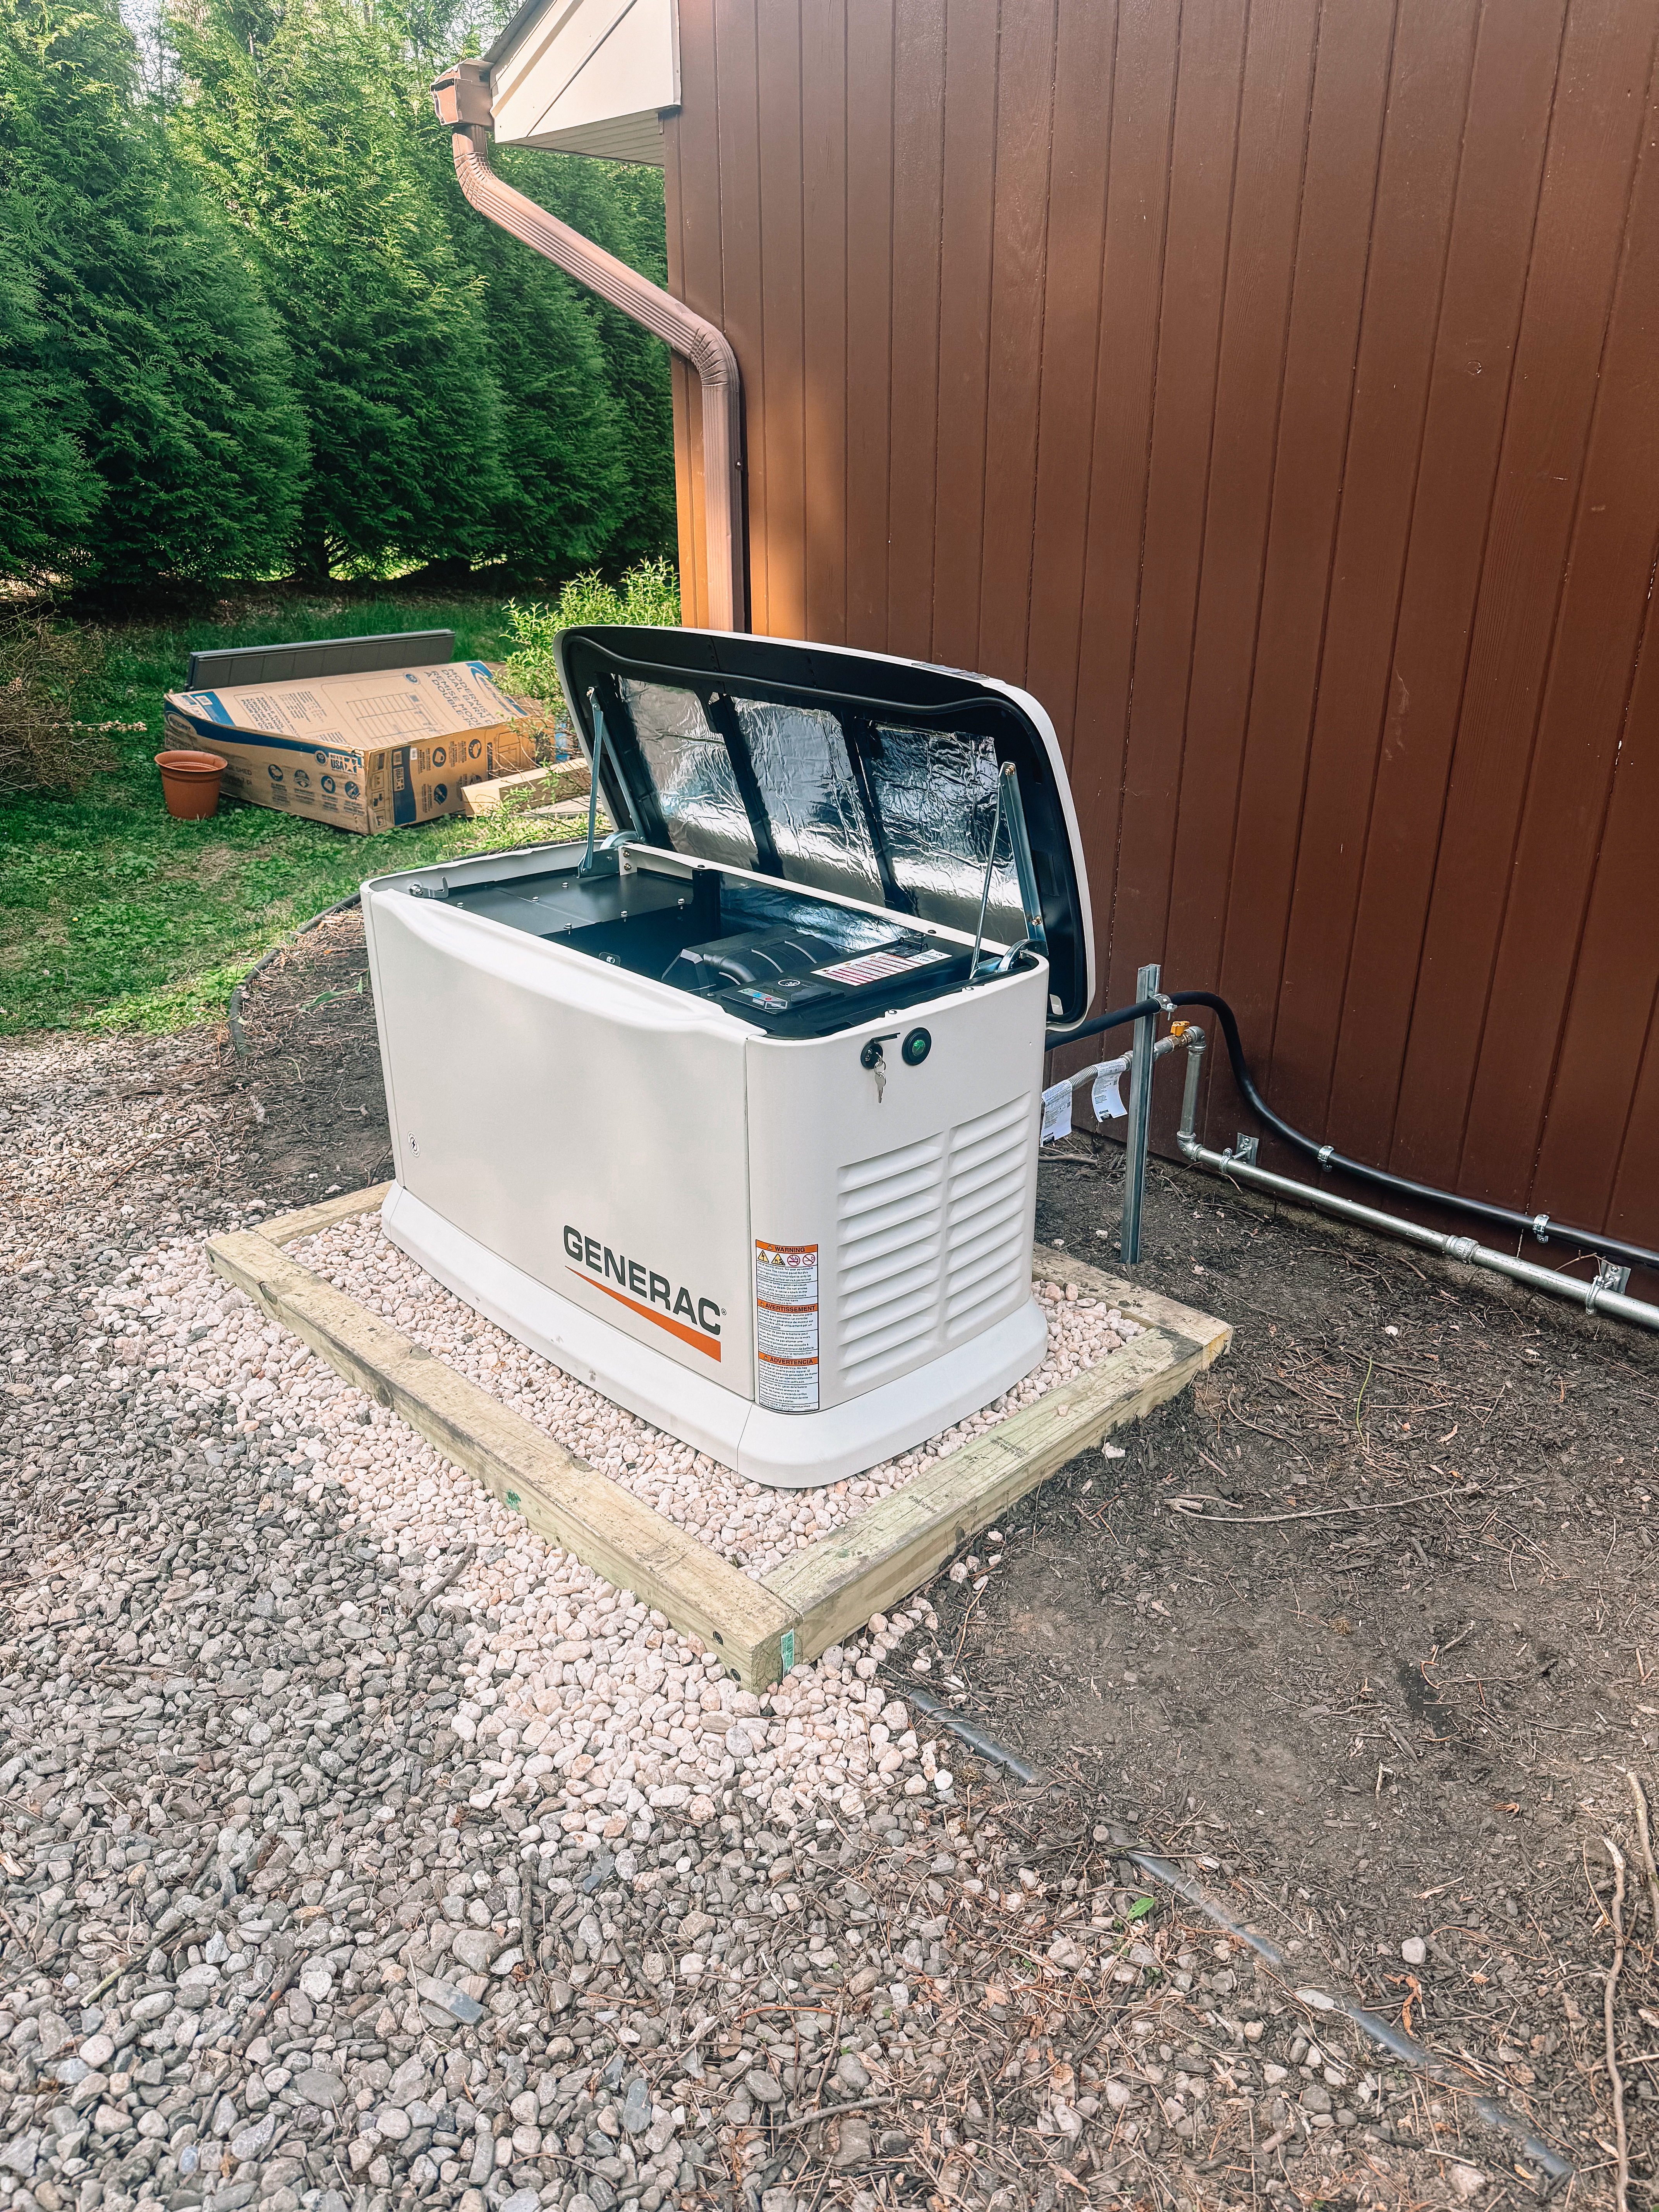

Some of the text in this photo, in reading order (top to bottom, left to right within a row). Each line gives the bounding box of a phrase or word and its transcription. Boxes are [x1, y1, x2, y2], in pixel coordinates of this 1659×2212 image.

[430, 671, 461, 702] REMISE
[440, 669, 465, 692] DUAL
[462, 695, 486, 718] BARN
[331, 759, 344, 771] USA
[563, 1225, 721, 1335] GENERAC
[765, 1302, 815, 1312] AVERTISSEMENT
[769, 1356, 813, 1365] ADVERTENCIA
